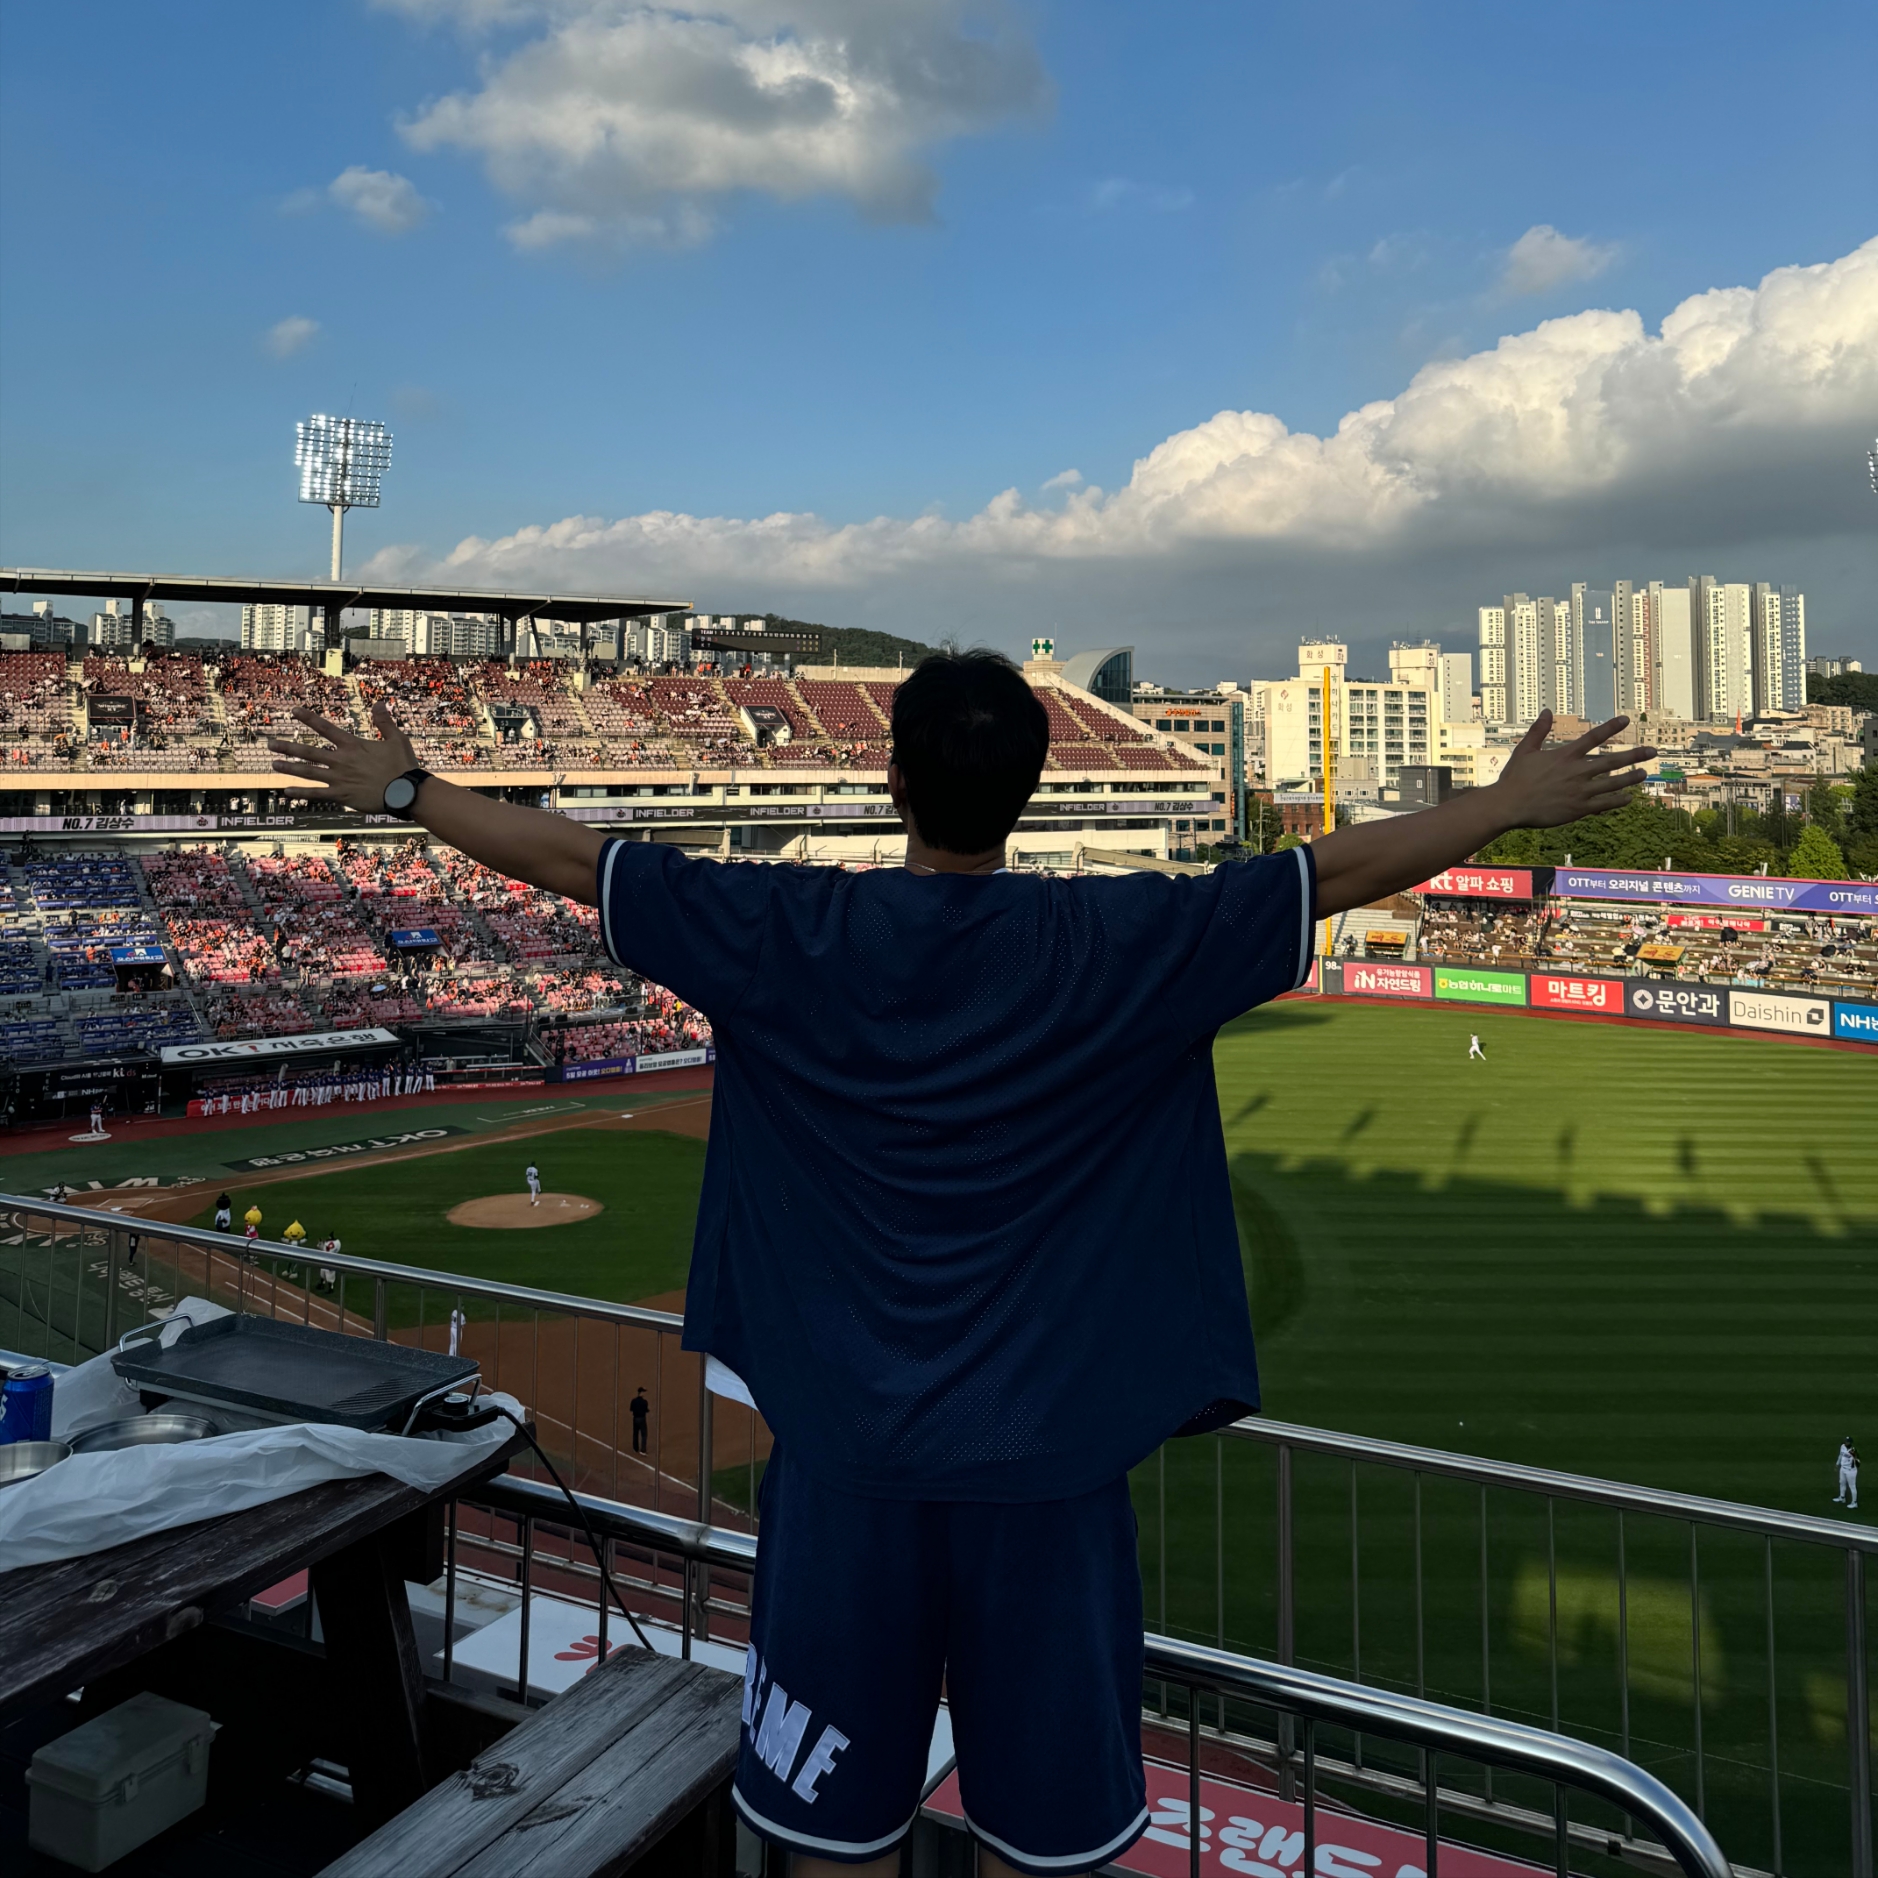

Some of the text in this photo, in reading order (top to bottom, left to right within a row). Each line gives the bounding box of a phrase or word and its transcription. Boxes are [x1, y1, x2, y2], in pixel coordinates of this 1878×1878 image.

[750, 806, 804, 816] INFIELDER
[864, 806, 884, 814] NO.7
[1060, 804, 1104, 812] INFIELDER
[1154, 802, 1194, 811] NO.7 김상수
[636, 808, 694, 818] INFIELDER
[62, 818, 134, 830] NO.7 김상수
[221, 816, 294, 826] INFIELDER
[1456, 876, 1483, 892] 알파
[1486, 876, 1514, 893] 쇼핑
[1568, 878, 1700, 894] OTT부터 오리지널 콘텐츠까지
[1728, 885, 1794, 900] GENIE TV
[1829, 891, 1872, 904] OTT부터
[1548, 981, 1606, 1007] 마트킹
[1656, 990, 1720, 1018] 문안과
[1734, 1001, 1801, 1024] Daishin
[178, 1034, 377, 1058] OK 저축은행
[112, 1067, 124, 1078] kt
